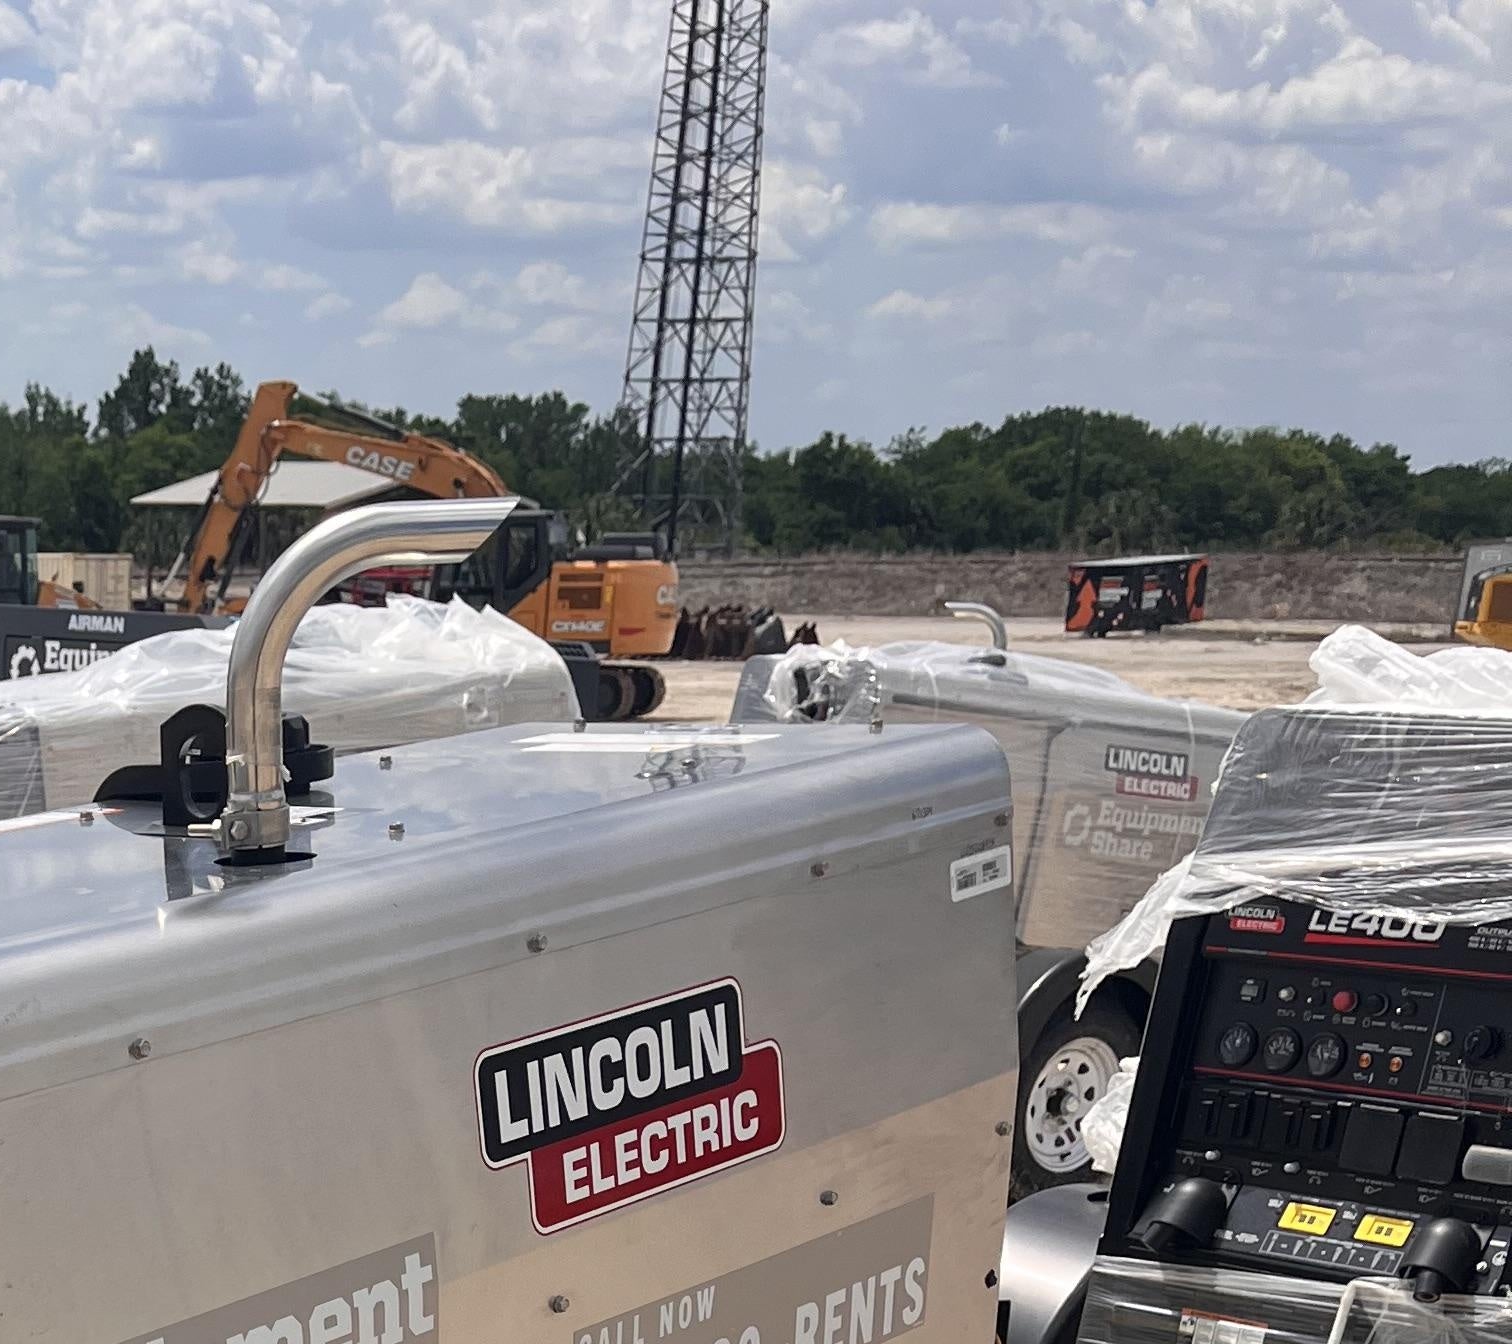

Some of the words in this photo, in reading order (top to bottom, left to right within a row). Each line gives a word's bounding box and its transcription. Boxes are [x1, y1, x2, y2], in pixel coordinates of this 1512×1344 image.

[346, 446, 415, 480] CASE
[68, 614, 125, 633] AIRMAN
[1109, 748, 1185, 777] LINCOLN
[1124, 777, 1191, 798] ELECTRIC
[1097, 801, 1204, 836] Equipmen
[1090, 832, 1153, 859] Share
[1229, 906, 1276, 920] LINCOLN
[495, 1004, 730, 1144] LINCOLN
[563, 1090, 760, 1204] ELECTRIC
[659, 1286, 716, 1339] NOW
